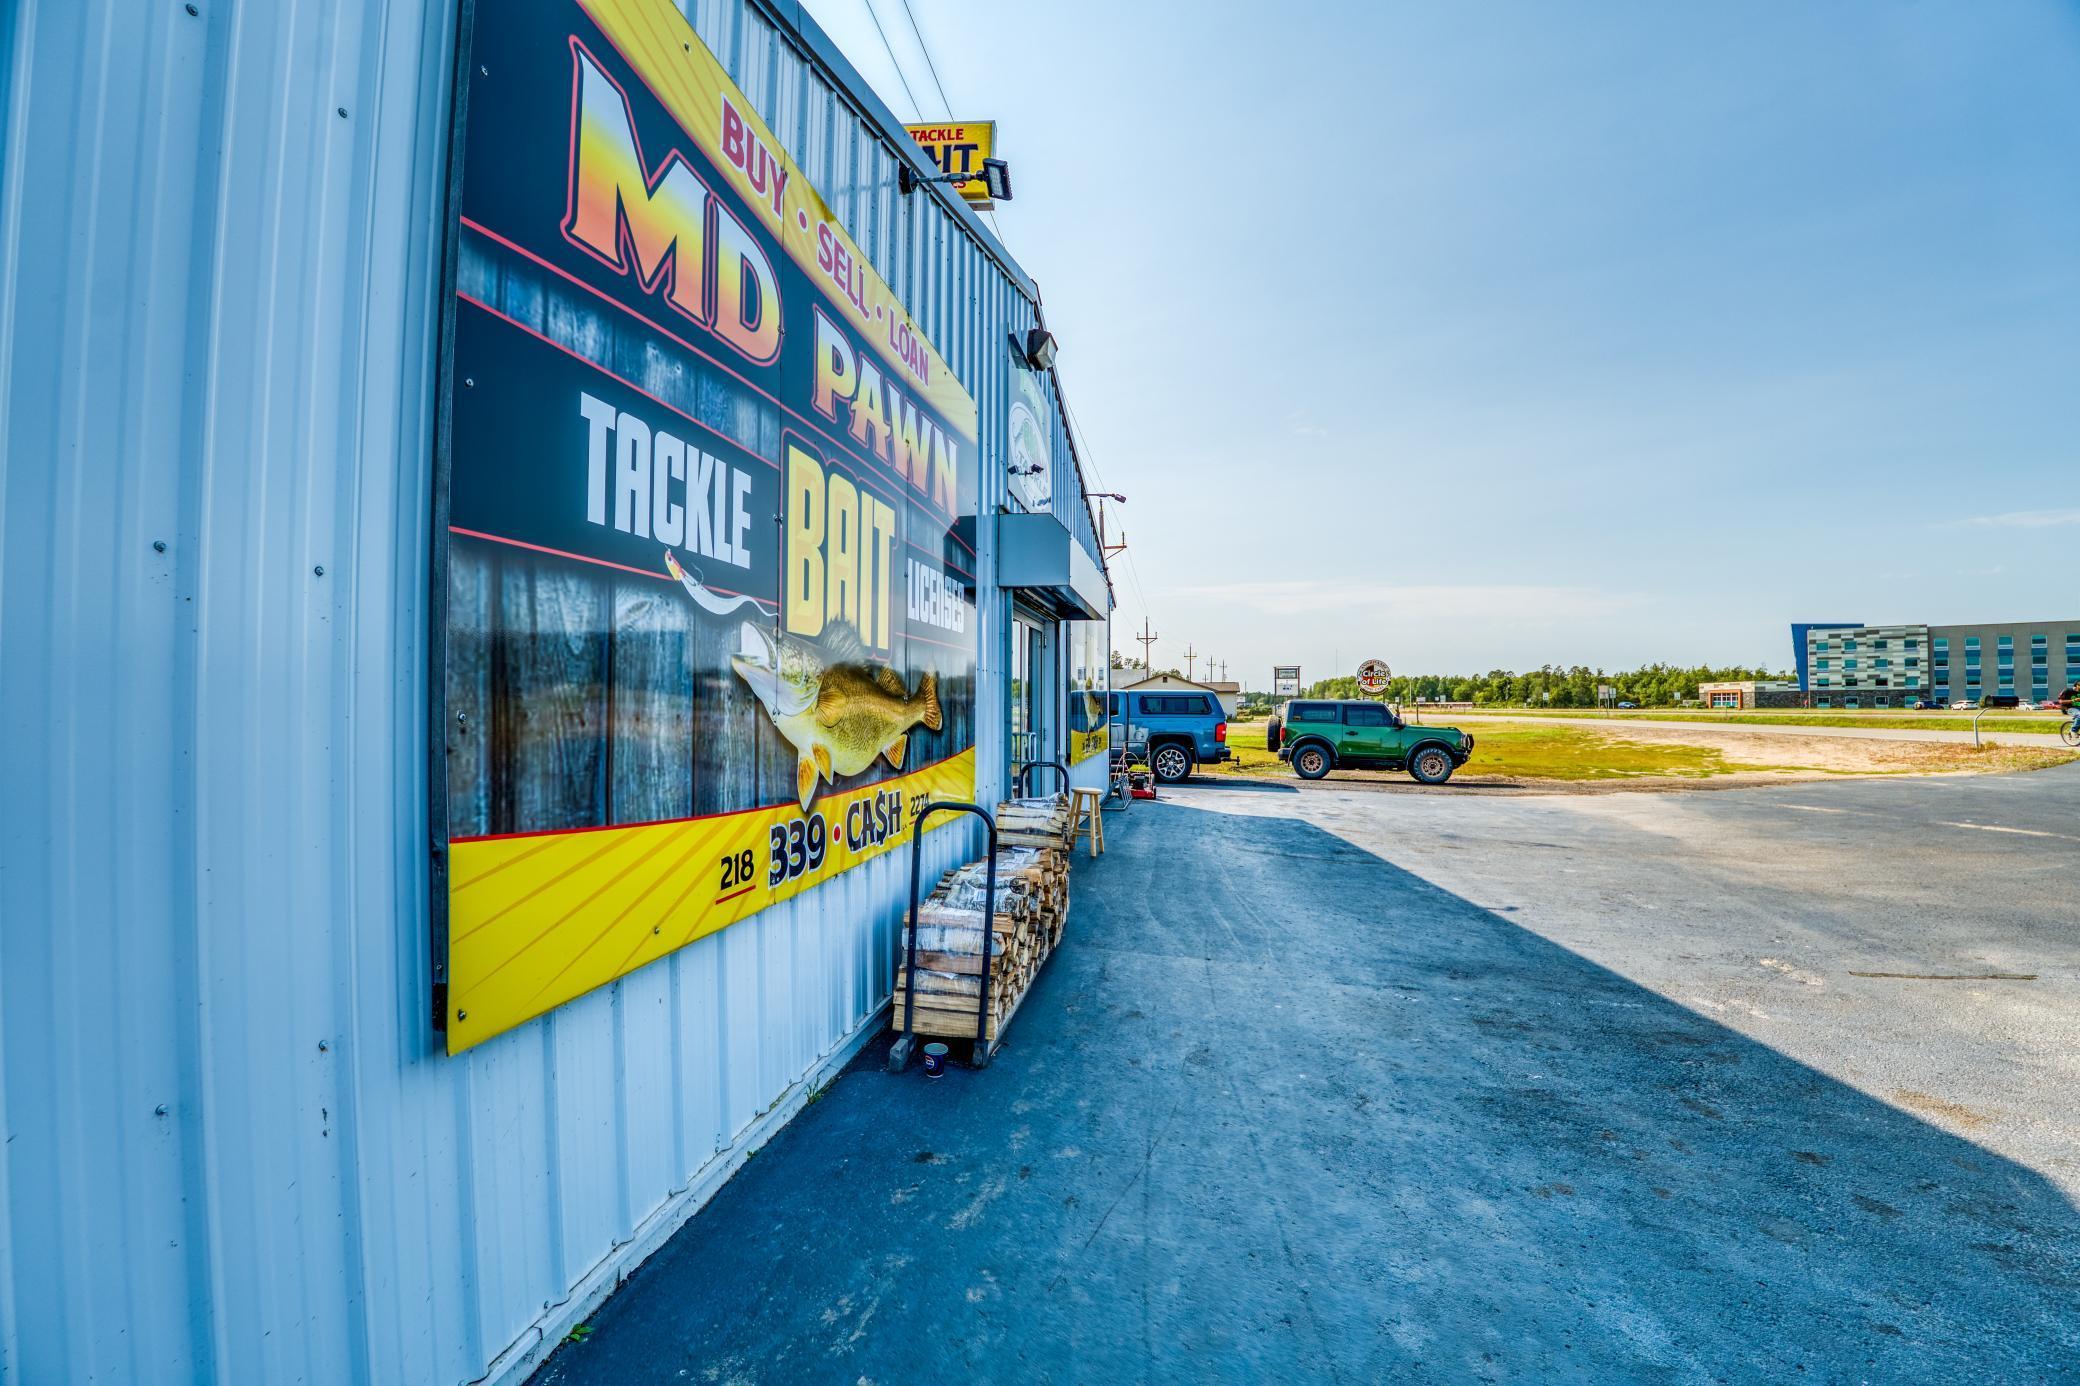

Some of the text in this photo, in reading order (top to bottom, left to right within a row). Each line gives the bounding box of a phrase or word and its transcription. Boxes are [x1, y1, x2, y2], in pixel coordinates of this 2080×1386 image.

[562, 36, 784, 366] MD
[910, 128, 965, 142] TACKLE
[721, 91, 930, 386] BUY SELL LOAN
[580, 391, 752, 570] TACKLE
[812, 304, 959, 521] PAWN
[786, 444, 896, 651] BAIT
[907, 557, 965, 634] LICENSES
[1361, 669, 1387, 677] Circle
[719, 848, 756, 890] 218
[768, 811, 827, 890] 339
[846, 788, 903, 853] CA$H
